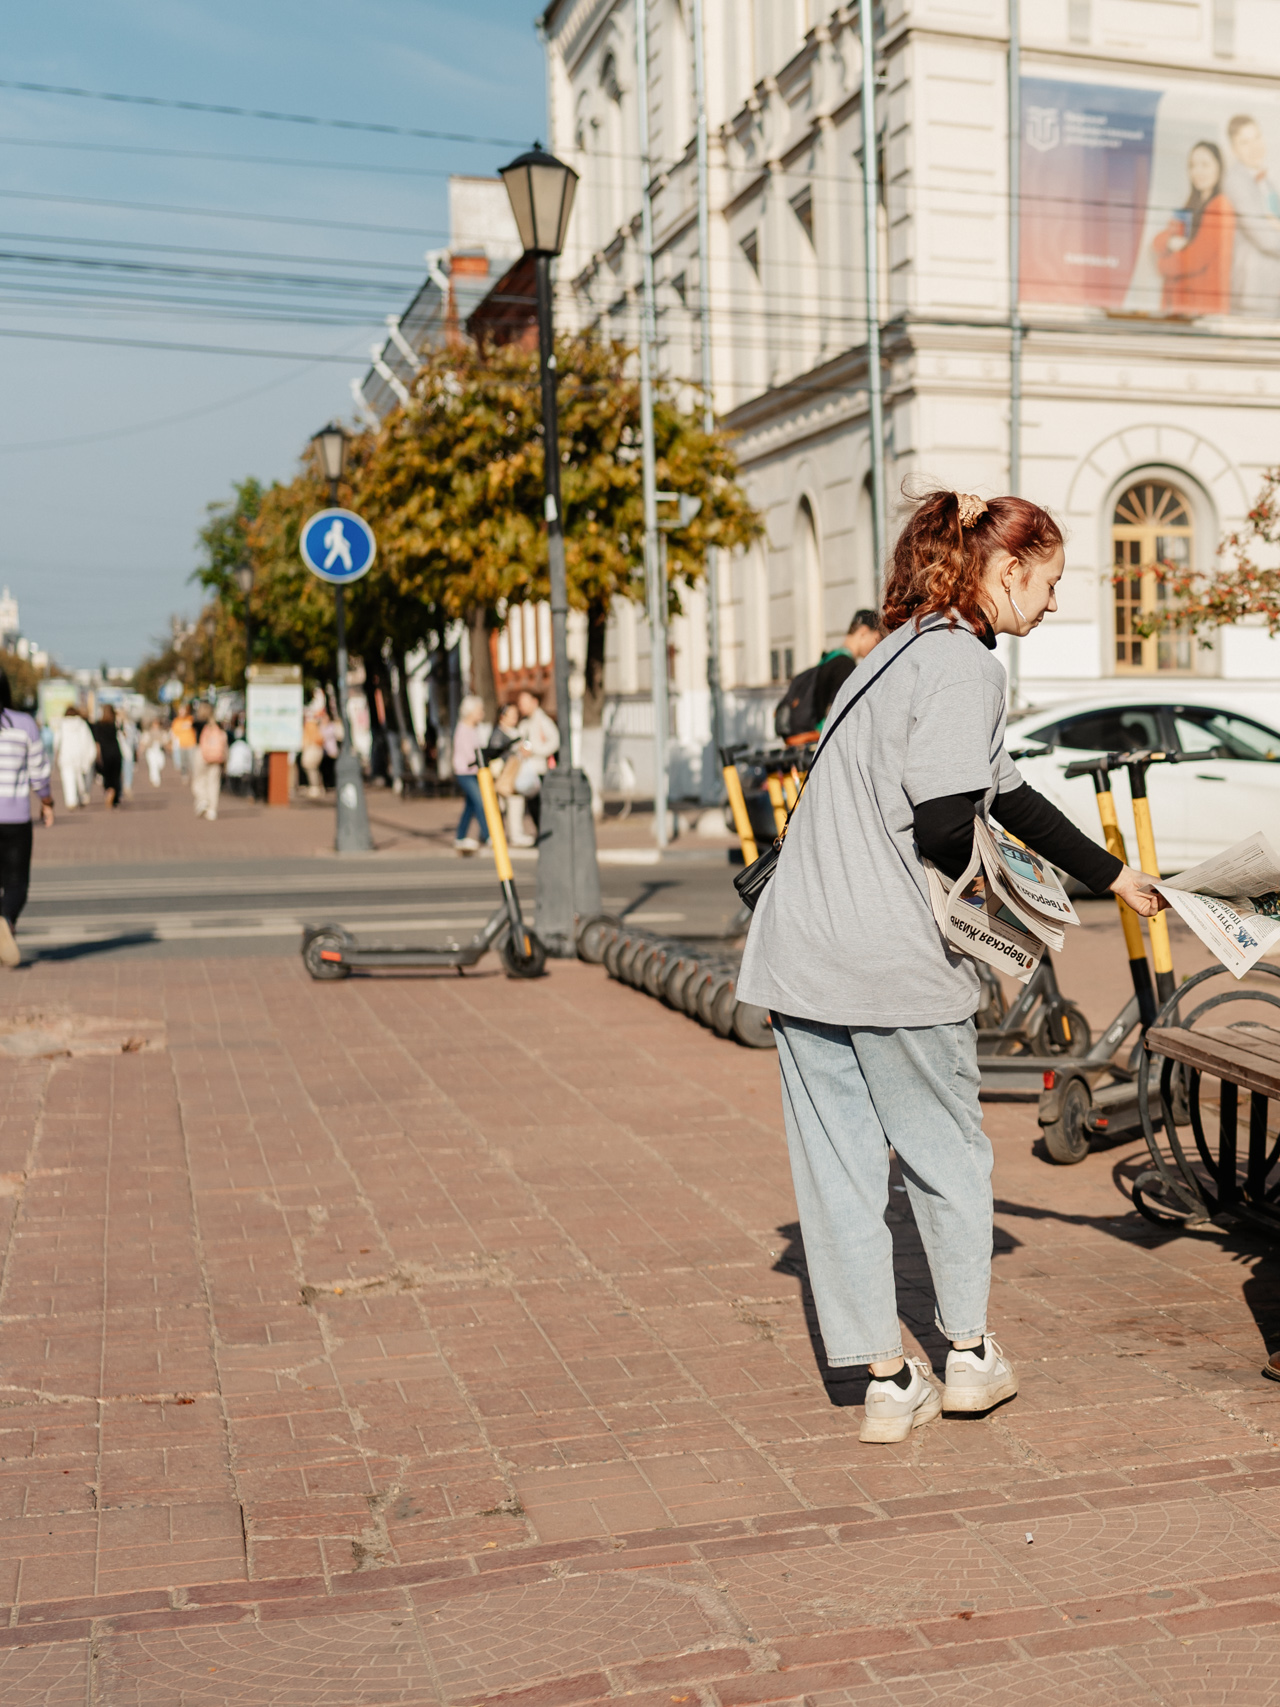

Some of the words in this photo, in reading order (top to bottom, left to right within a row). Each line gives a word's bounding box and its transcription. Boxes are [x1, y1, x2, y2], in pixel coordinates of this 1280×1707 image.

[950, 915, 981, 941] Жизнь
[1216, 913, 1235, 933] Эти
[978, 932, 1029, 967] Тверская
